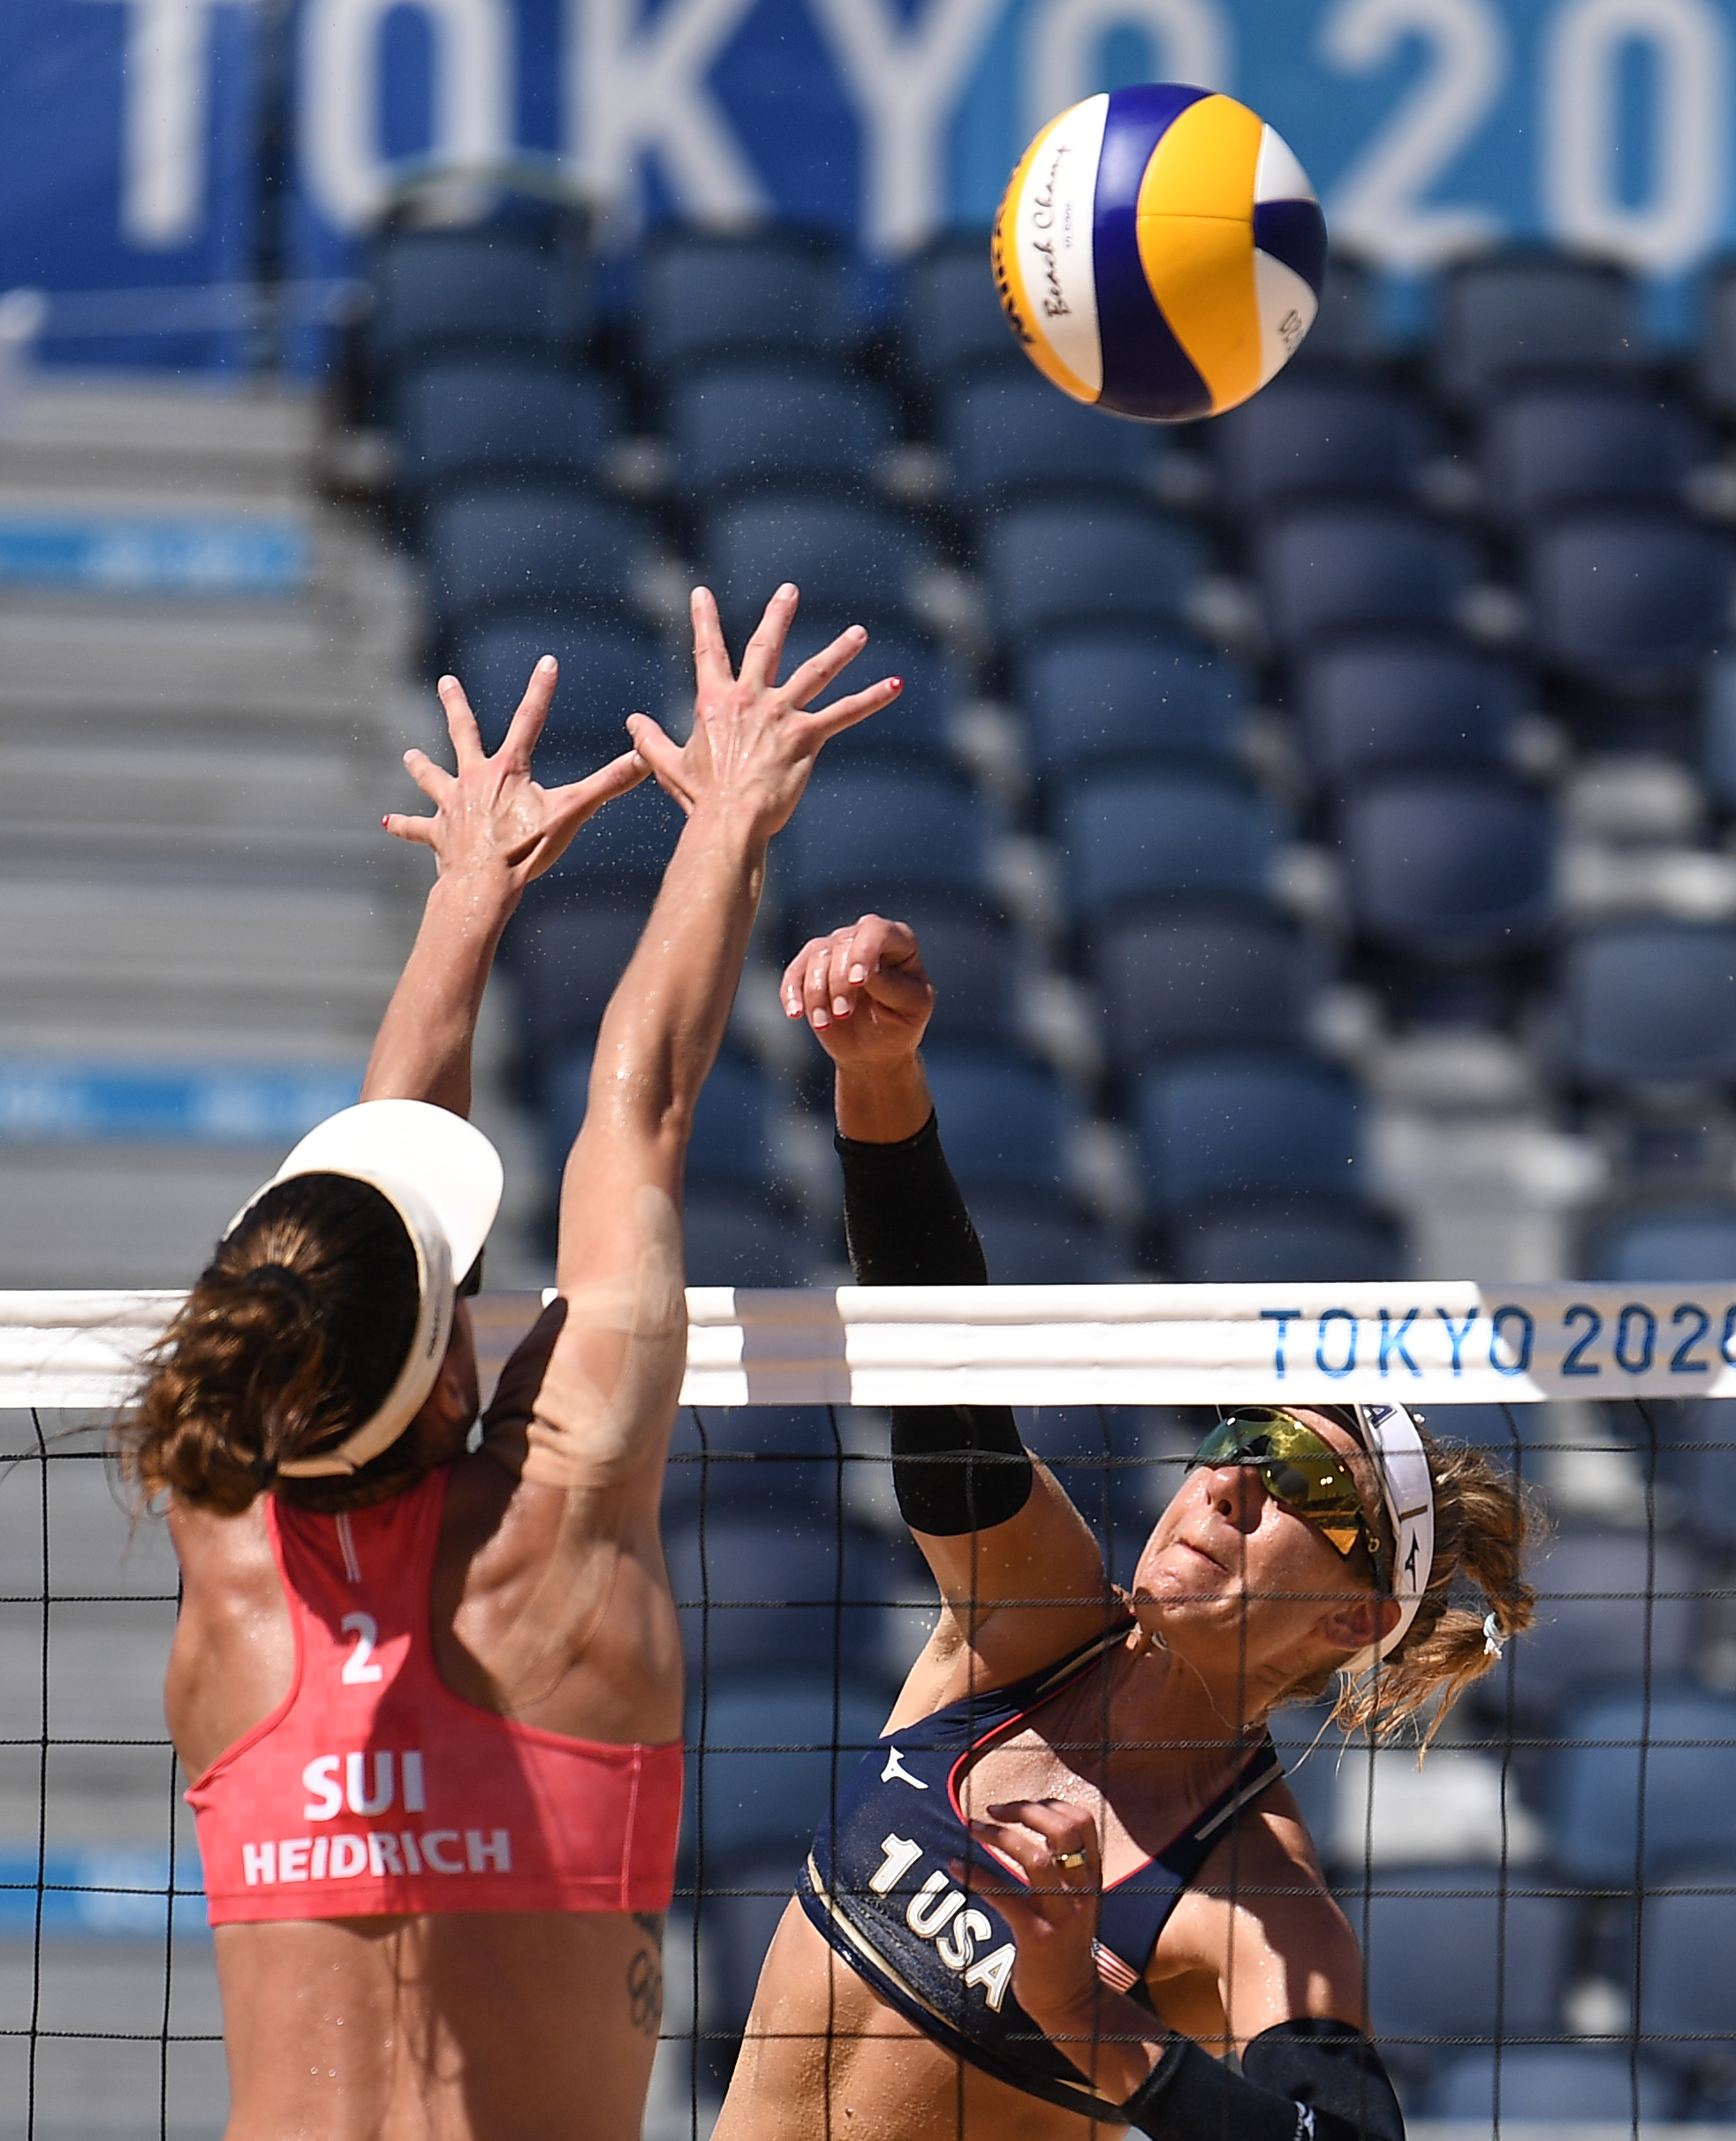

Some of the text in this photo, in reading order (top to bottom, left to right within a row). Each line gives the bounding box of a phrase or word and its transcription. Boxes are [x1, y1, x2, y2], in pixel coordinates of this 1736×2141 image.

[1261, 1308, 1535, 1380] TOKYO
[340, 1612, 383, 1685] 2
[301, 1750, 426, 1822] SUI
[241, 1827, 512, 1887] HEIDRICH
[868, 1833, 1016, 2013] 1 USA
